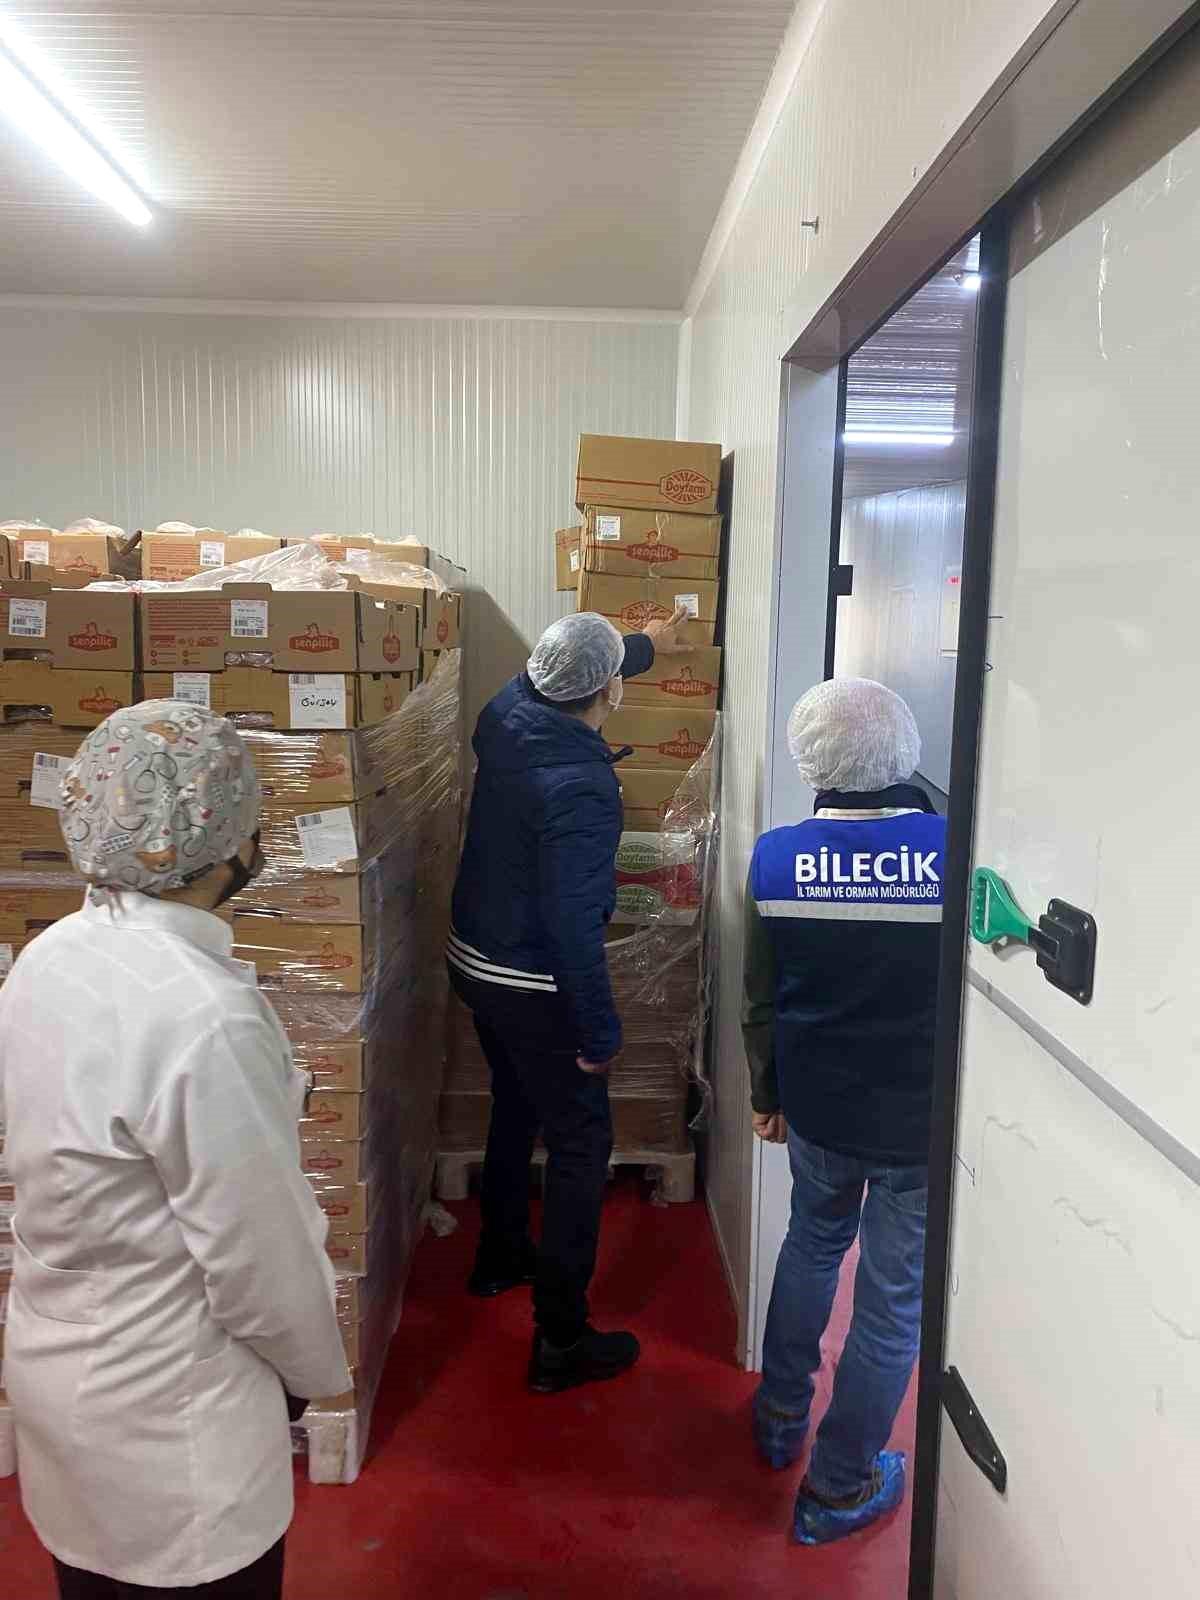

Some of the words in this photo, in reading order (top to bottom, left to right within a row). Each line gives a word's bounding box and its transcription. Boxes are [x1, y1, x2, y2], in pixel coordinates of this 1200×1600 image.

[795, 845, 940, 883] BİLECİK
[806, 885, 831, 898] TARIM
[832, 885, 845, 898] VE
[845, 885, 879, 898] ORMAN
[880, 884, 940, 898] MÜDÜRLÜĞÜ
